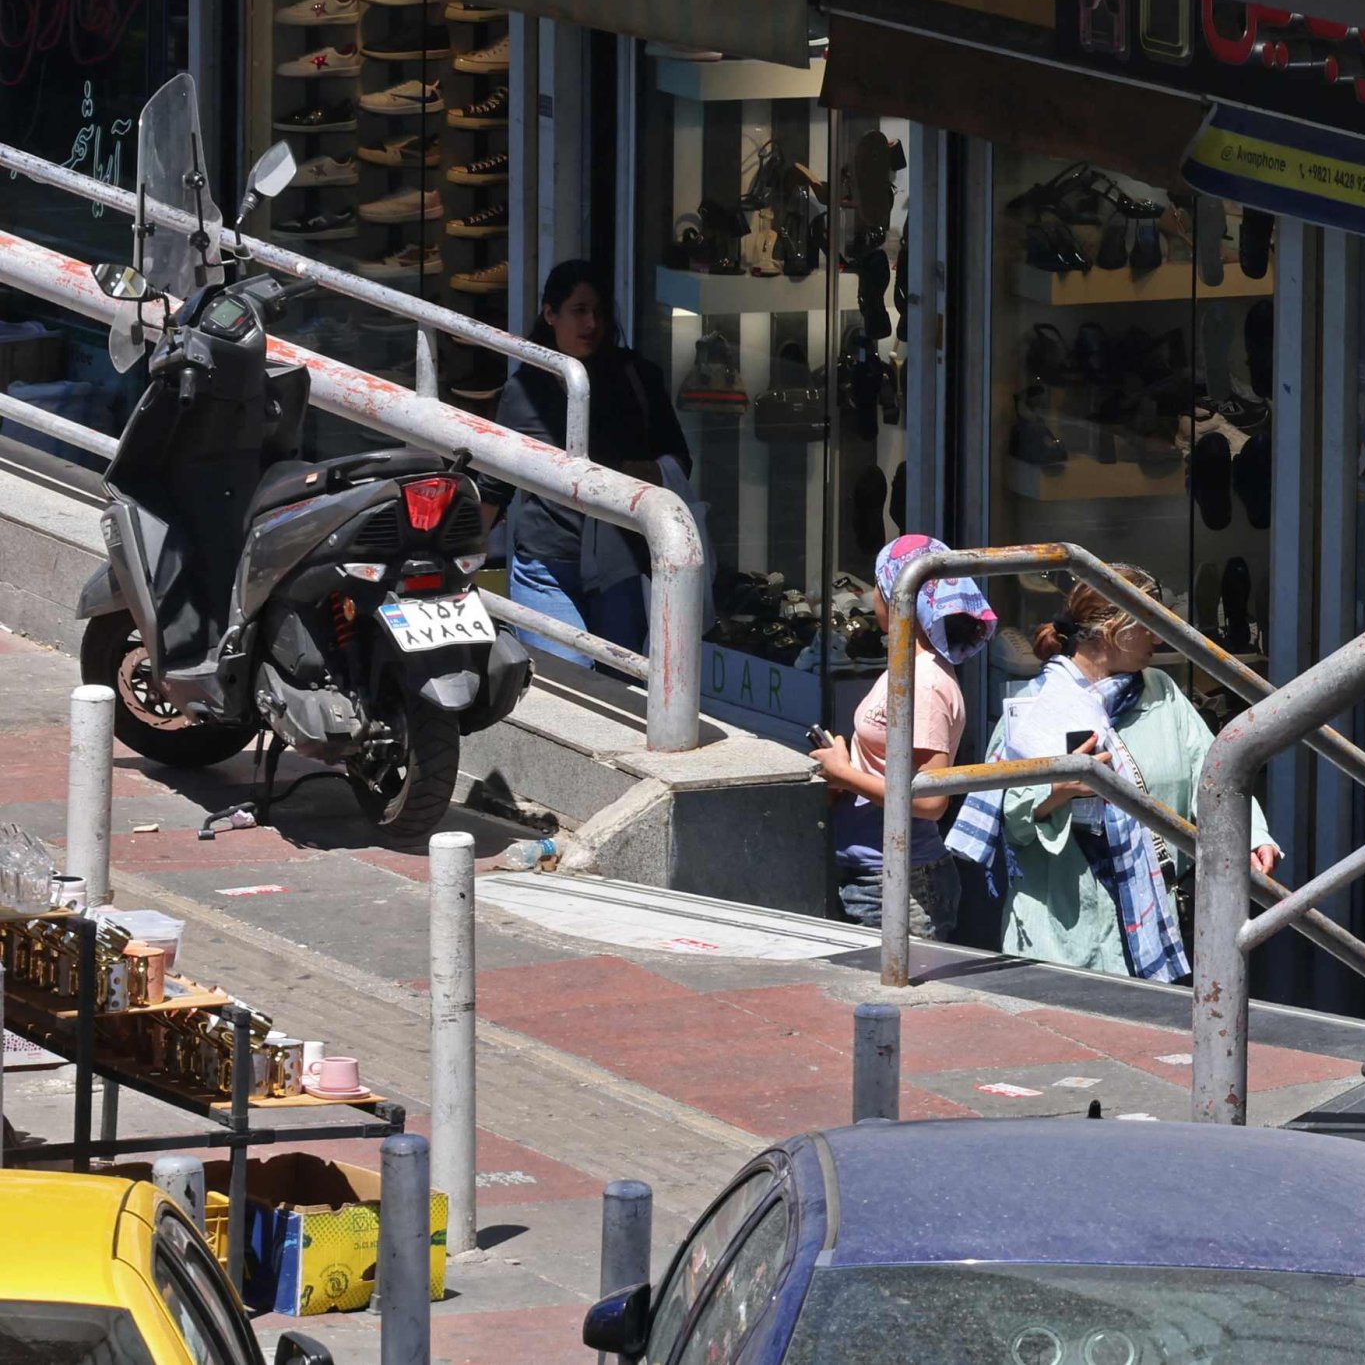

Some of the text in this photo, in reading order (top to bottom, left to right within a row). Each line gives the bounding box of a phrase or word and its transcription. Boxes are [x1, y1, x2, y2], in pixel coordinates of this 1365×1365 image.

[1237, 144, 1286, 173] Avanphone
[1308, 165, 1332, 185] +9821
[1334, 171, 1356, 191] 4428
[406, 621, 490, 645] ۸۷۸۹۹
[712, 649, 783, 713] DAR
